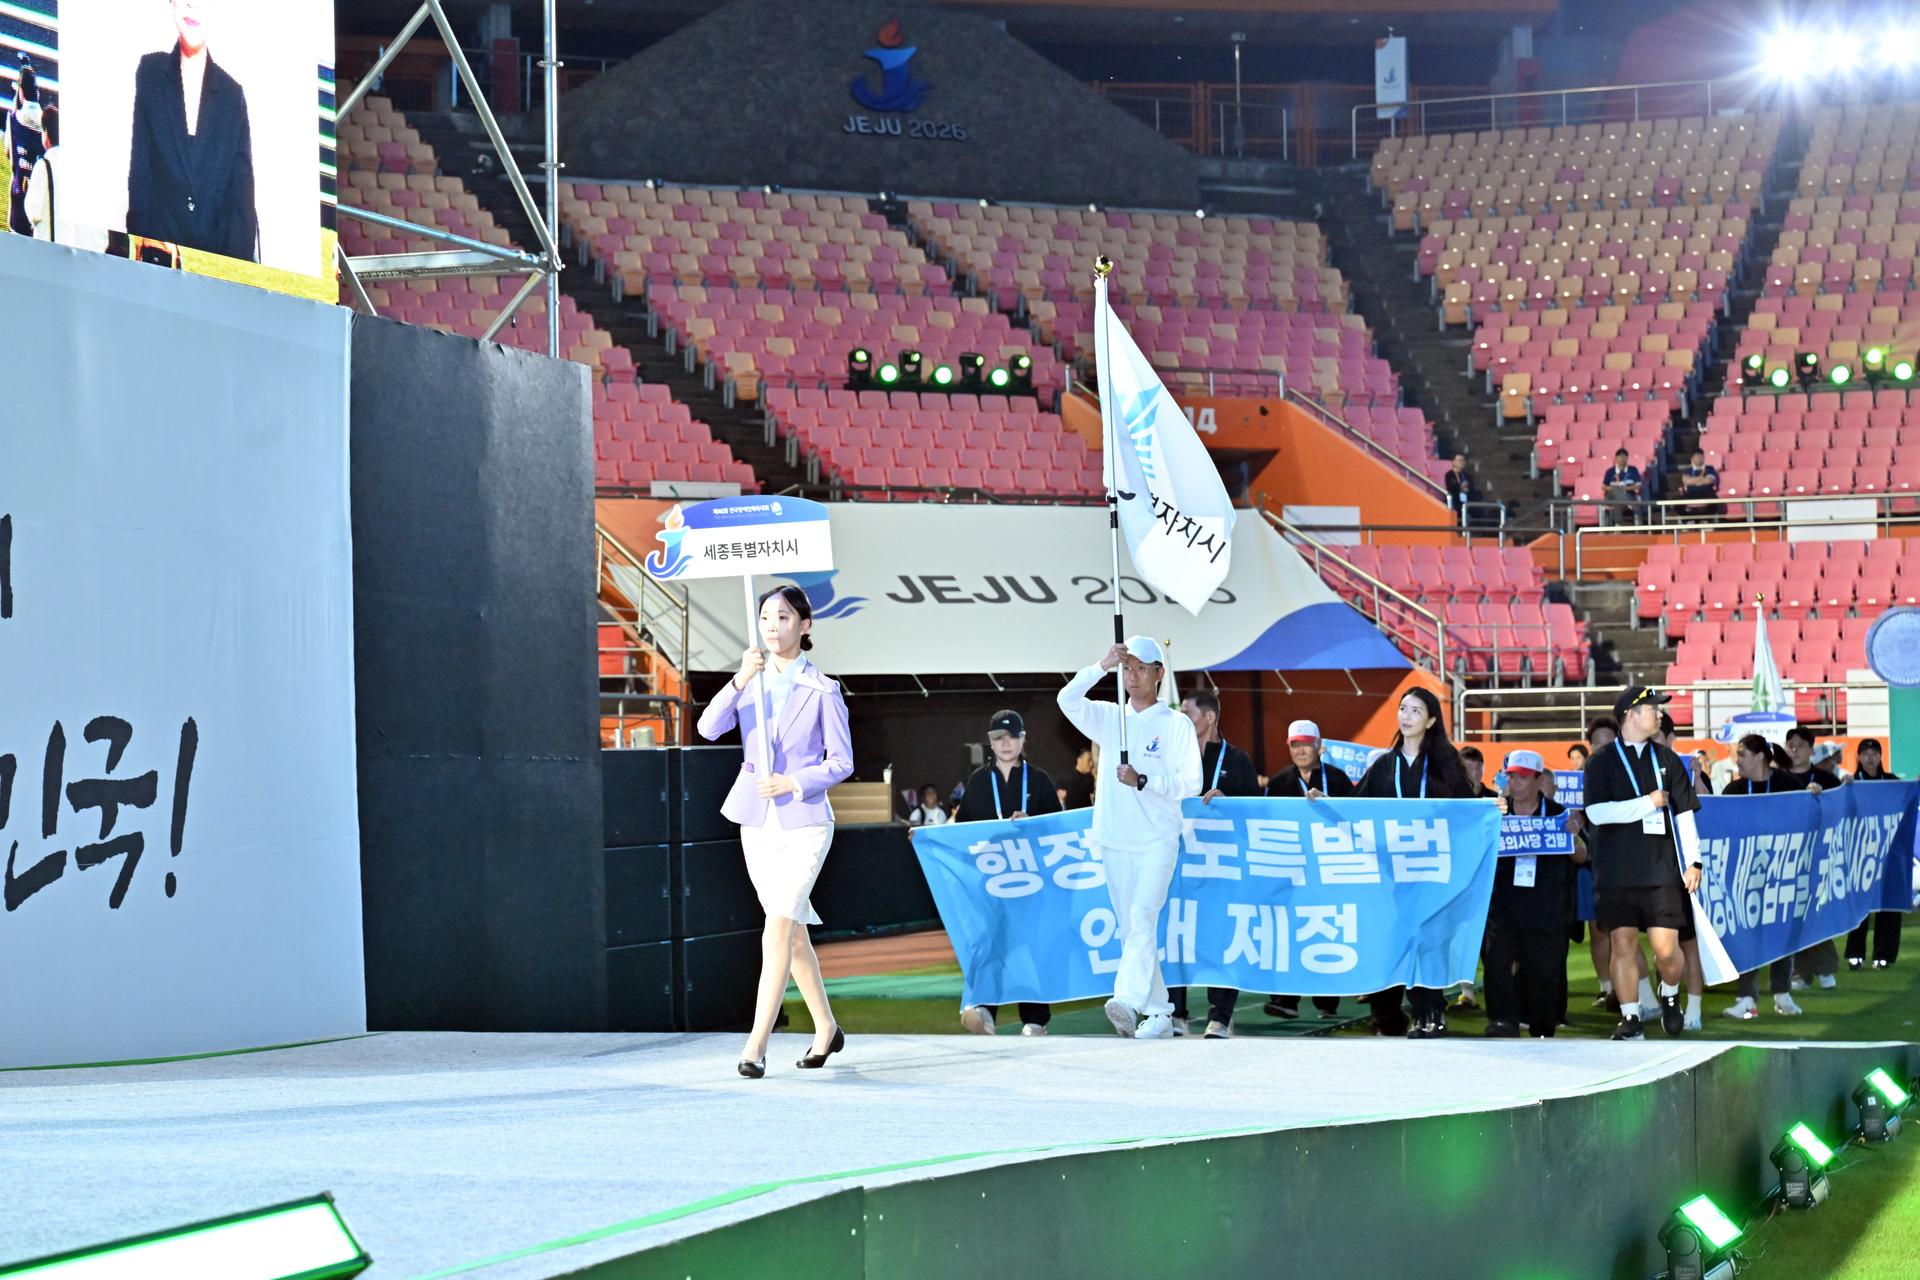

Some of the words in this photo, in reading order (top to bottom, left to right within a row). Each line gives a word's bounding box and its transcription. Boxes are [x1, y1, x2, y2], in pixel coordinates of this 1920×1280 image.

[843, 115, 902, 136] JEJU
[909, 120, 967, 141] 2026
[703, 538, 799, 560] 세종특별자치시
[1151, 493, 1226, 563] 자치시
[885, 575, 1058, 604] JEJU
[968, 818, 1451, 898] 행정도특별법
[1223, 903, 1358, 975] 제정
